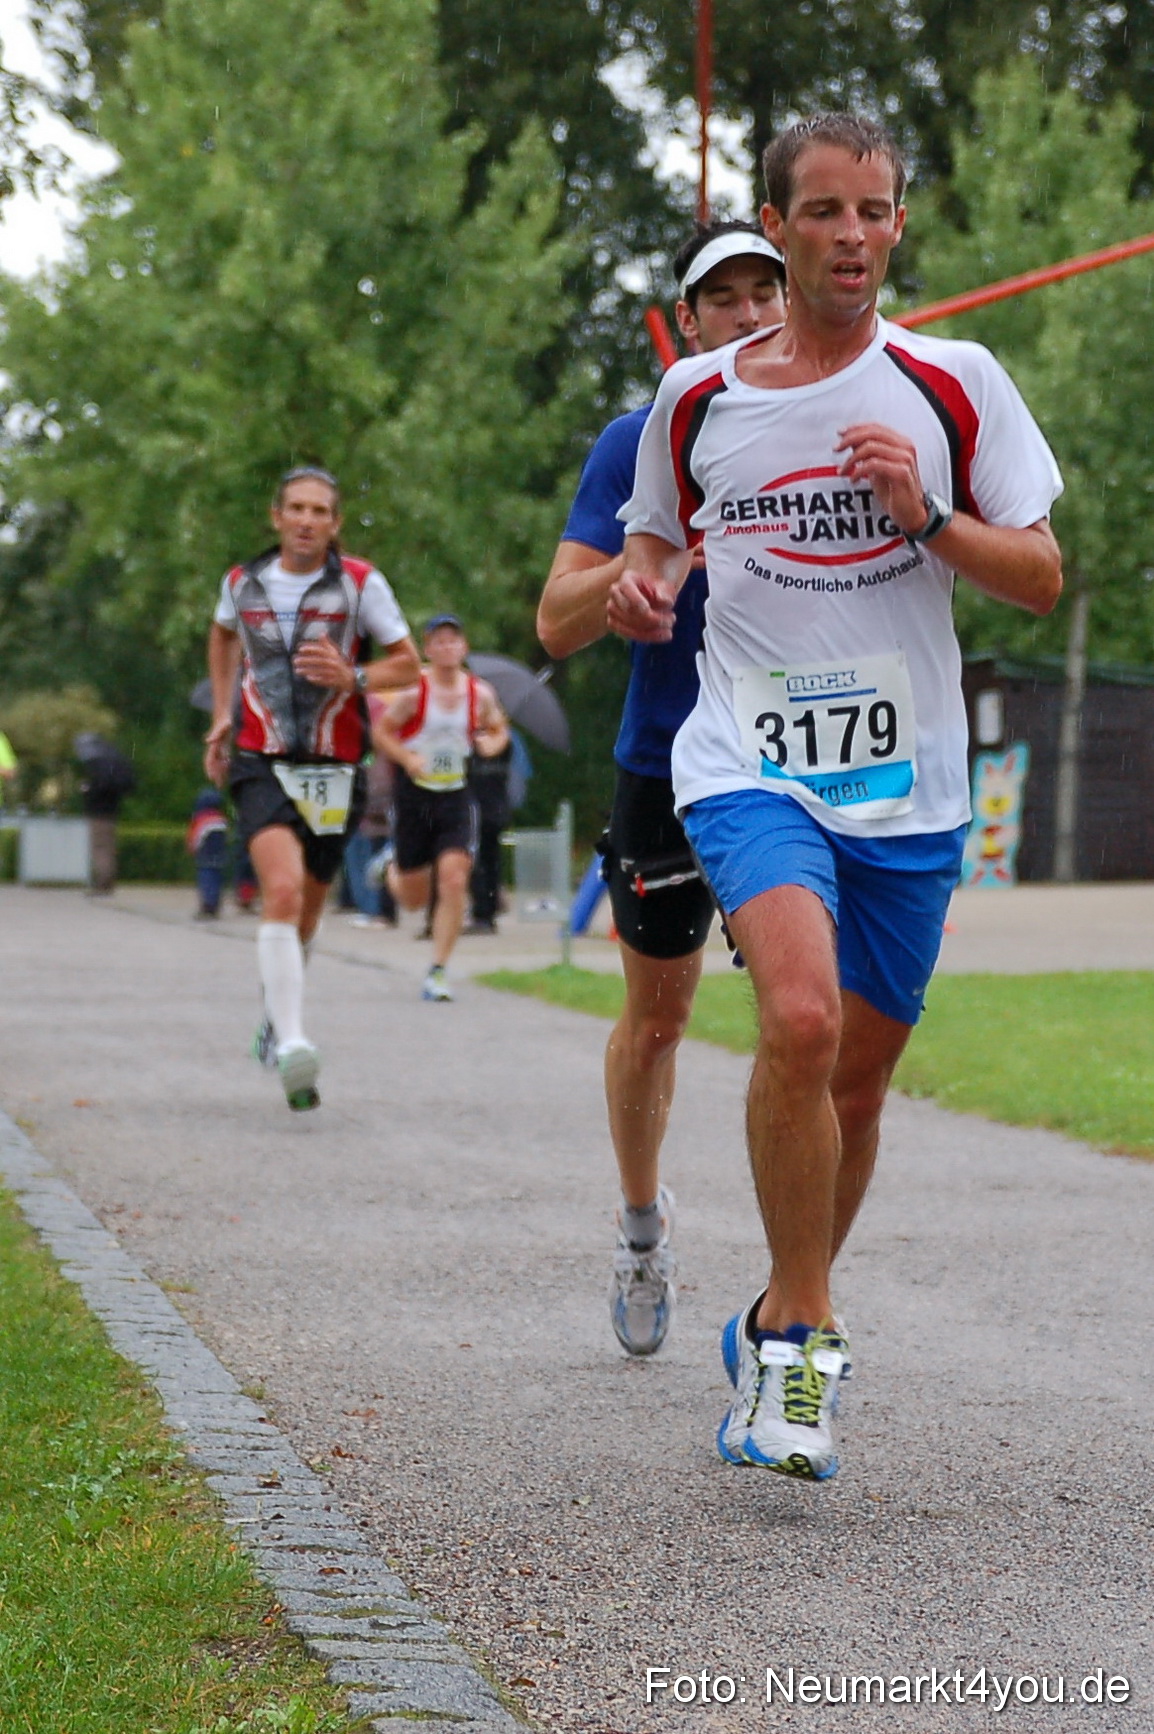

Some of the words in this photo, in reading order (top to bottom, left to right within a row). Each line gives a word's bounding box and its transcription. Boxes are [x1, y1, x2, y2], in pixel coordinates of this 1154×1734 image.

[720, 490, 874, 521] GERHART
[723, 521, 789, 536] Autohaus
[789, 515, 902, 543] JÄNIG
[744, 557, 772, 580] Das
[774, 572, 853, 593] sportliche
[857, 554, 923, 587] Autohaus
[786, 670, 857, 692] BOCK
[755, 699, 897, 769] 3179
